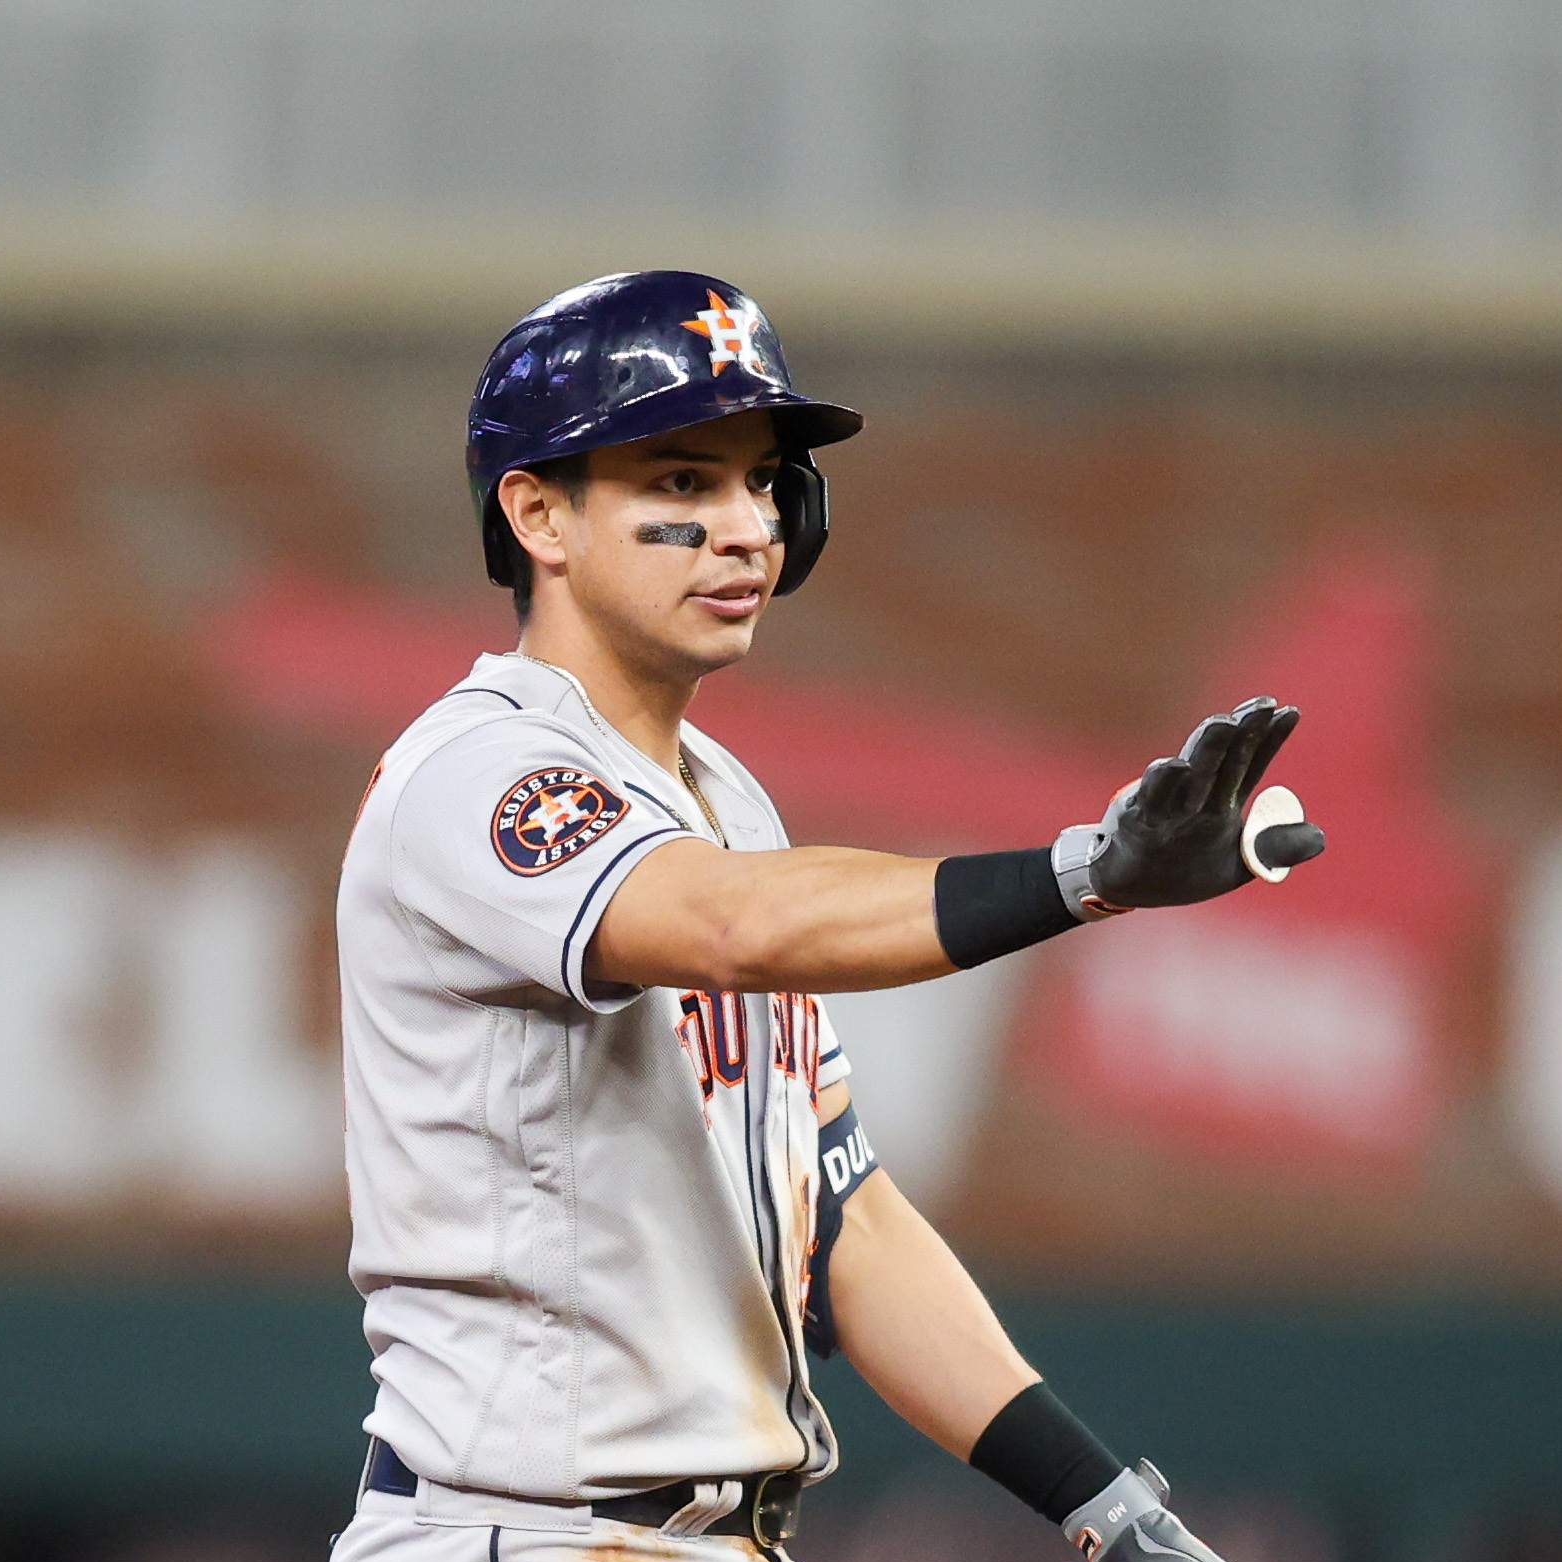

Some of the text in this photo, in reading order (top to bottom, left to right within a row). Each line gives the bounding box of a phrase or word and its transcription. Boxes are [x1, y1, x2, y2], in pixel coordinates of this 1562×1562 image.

[695, 309, 760, 363] H
[499, 771, 595, 831] HOUSTON
[534, 810, 618, 866] ASTROS
